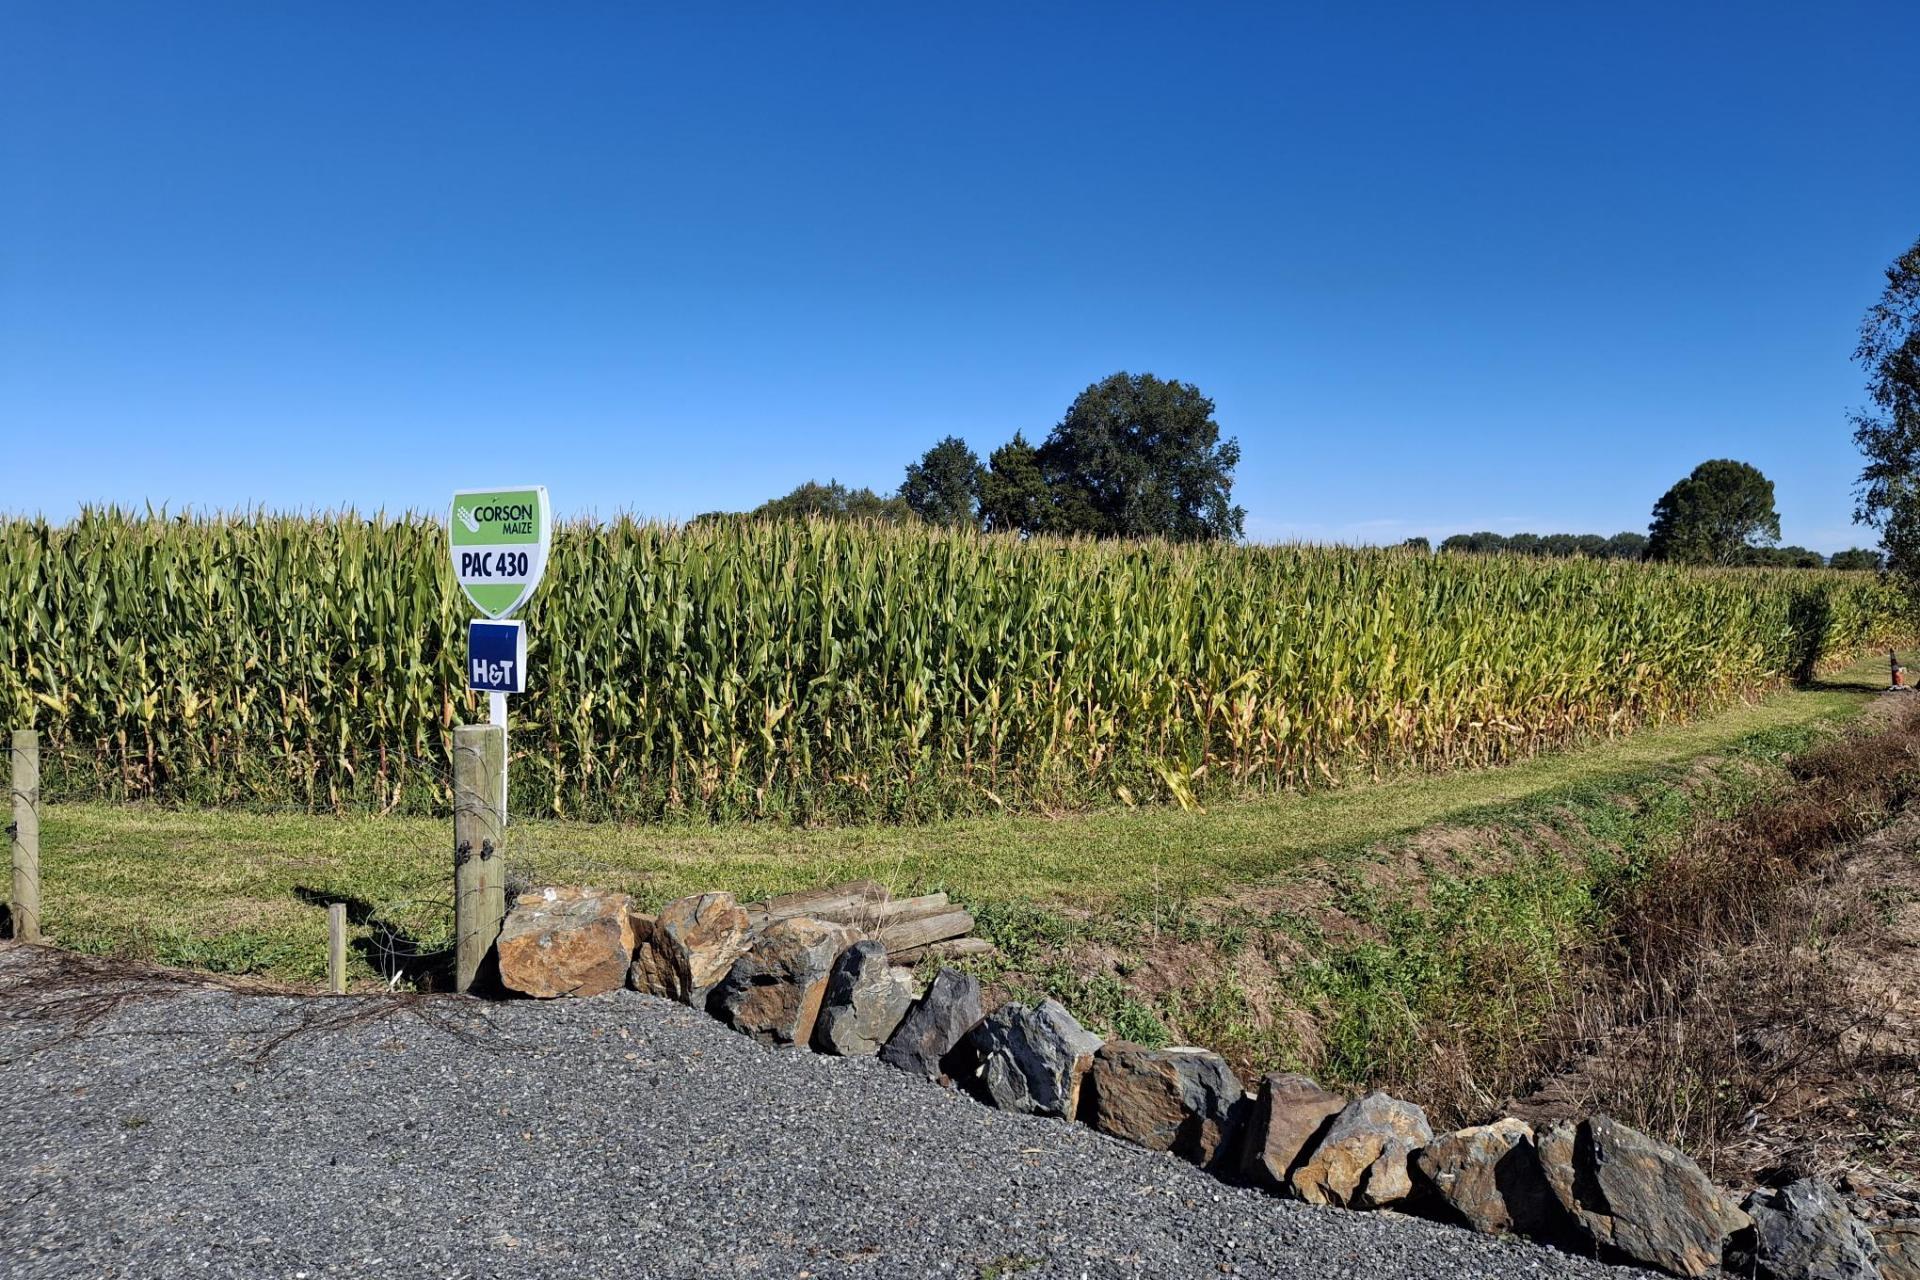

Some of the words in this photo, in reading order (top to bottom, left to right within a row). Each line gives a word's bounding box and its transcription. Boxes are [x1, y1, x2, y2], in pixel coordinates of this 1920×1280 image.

[474, 504, 533, 522] CORSON
[502, 522, 533, 535] MAIZE
[461, 553, 492, 577] PAC
[495, 552, 529, 577] 430
[472, 658, 514, 686] H&T
